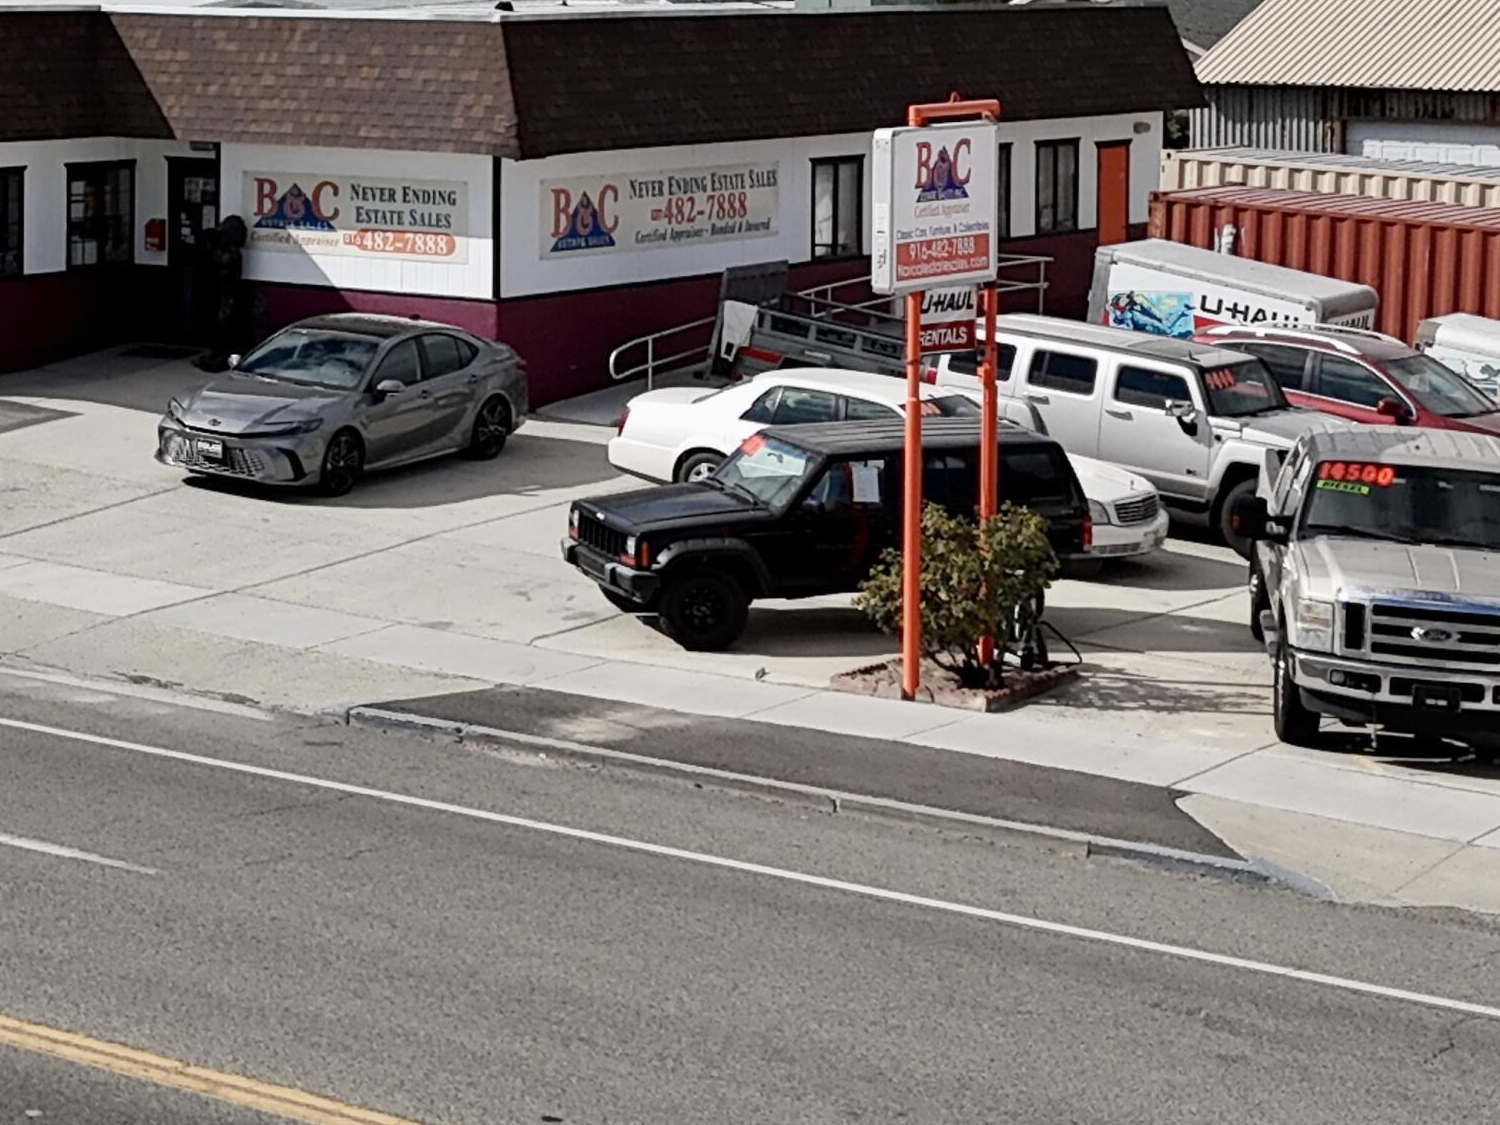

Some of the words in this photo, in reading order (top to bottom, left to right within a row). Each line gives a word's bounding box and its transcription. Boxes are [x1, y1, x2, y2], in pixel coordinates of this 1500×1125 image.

[350, 183, 397, 204] NEVER
[402, 185, 457, 207] ENDING
[629, 178, 665, 199] NEVER
[668, 175, 708, 196] ENDING
[711, 172, 747, 192] ESTATE
[749, 168, 778, 188] SALES
[253, 177, 340, 222] B&C
[551, 184, 619, 238] B&C
[663, 192, 748, 225] 482-7888
[355, 206, 405, 226] ESTATE
[409, 209, 452, 229] SALES
[251, 230, 296, 244] Certified
[297, 233, 340, 248] Appraiser
[362, 231, 448, 255] 482-7888
[635, 228, 668, 244] Certified
[670, 226, 704, 243] Appraiser
[710, 222, 736, 237] Bonded
[745, 218, 771, 232] Insured
[909, 236, 975, 261] 916-482-7888
[920, 326, 968, 347] RENTALS
